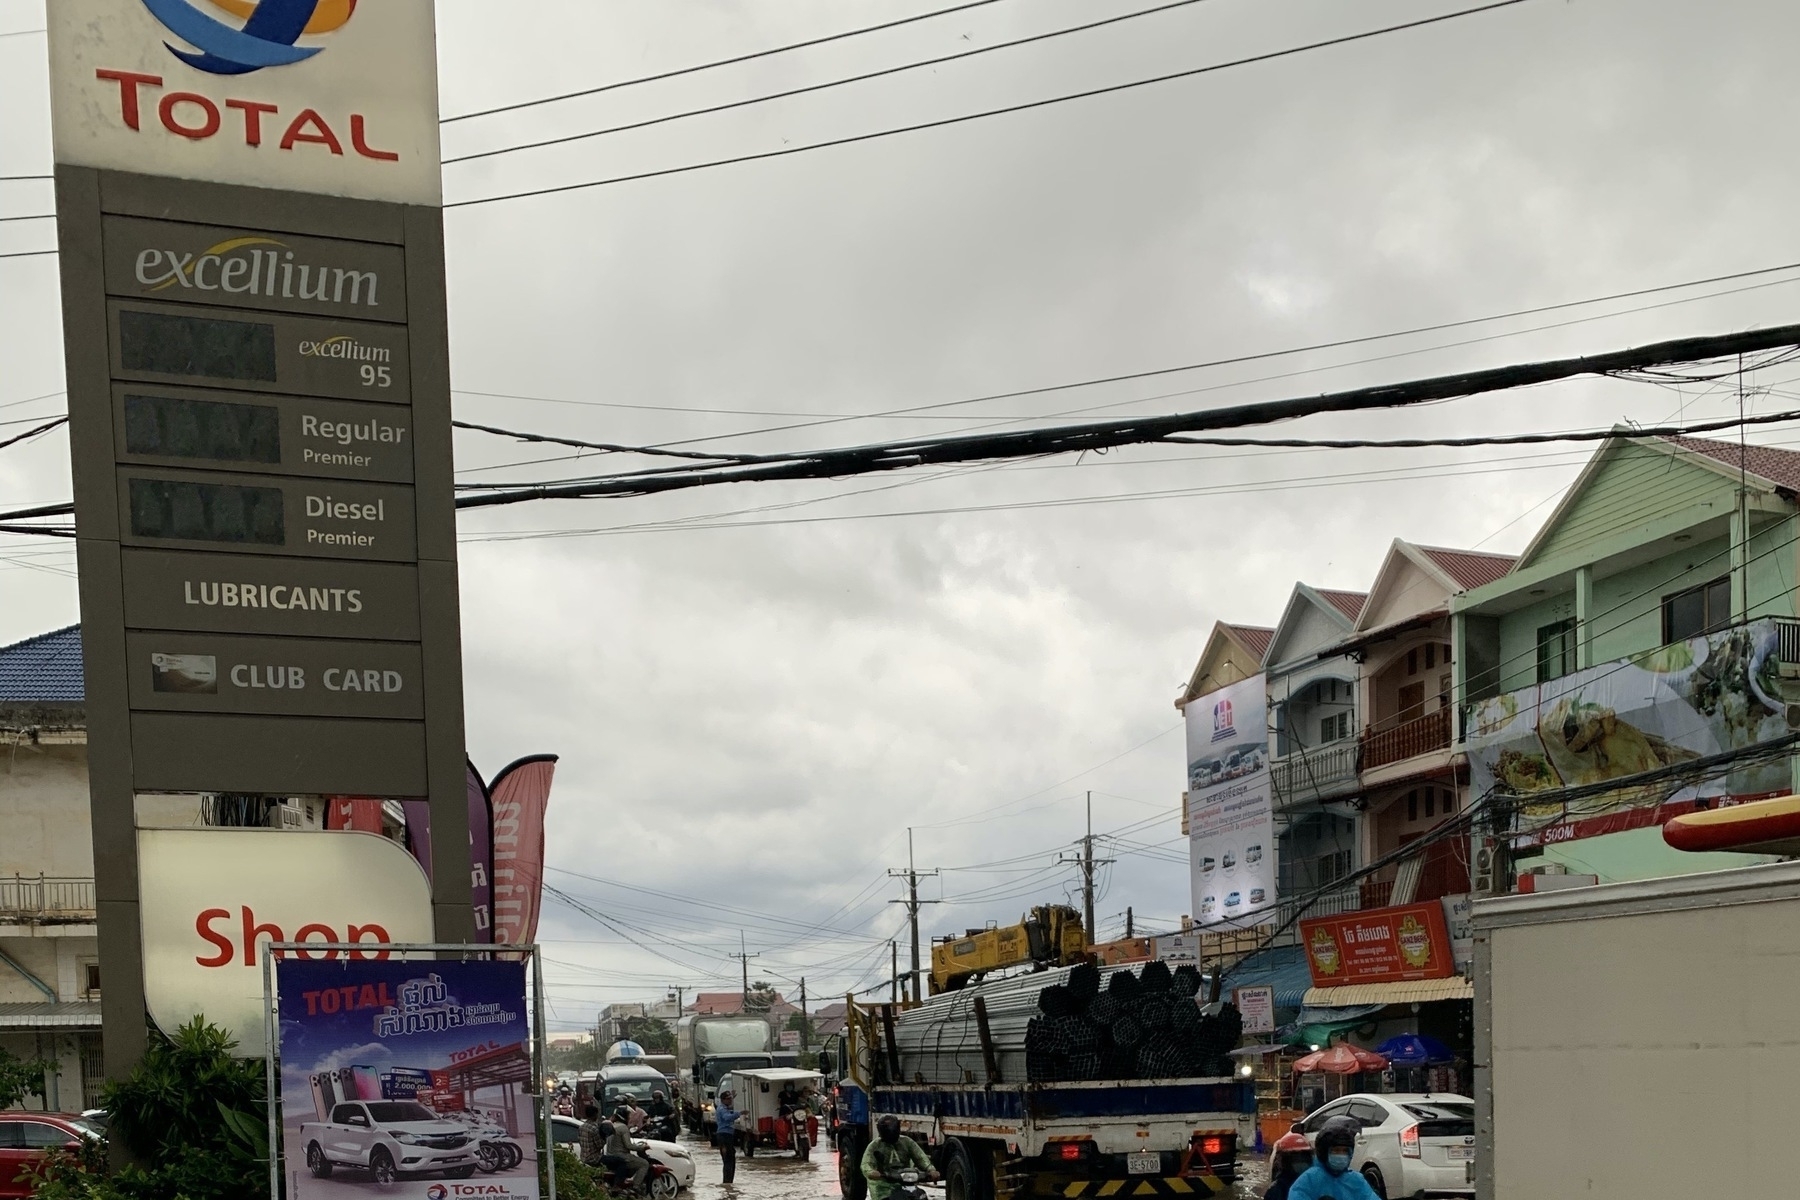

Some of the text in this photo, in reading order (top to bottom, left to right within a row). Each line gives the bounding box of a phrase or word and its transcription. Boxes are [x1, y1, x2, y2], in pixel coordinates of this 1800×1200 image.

[96, 69, 399, 161] TOTAL
[135, 244, 379, 306] excellium
[298, 338, 391, 363] excellium
[359, 365, 392, 388] 95
[302, 415, 405, 445] Regular
[303, 449, 371, 468] Premier
[305, 496, 385, 521] Diesel
[307, 529, 375, 547] Premier
[185, 580, 363, 613] LUBRICANTS
[230, 664, 403, 693] CLUB CARD
[1545, 824, 1575, 842] 500M
[195, 905, 390, 967] Shop
[303, 982, 398, 1016] TOTAL
[449, 1041, 500, 1062] TOTAL
[450, 1184, 510, 1196] TOTAL
